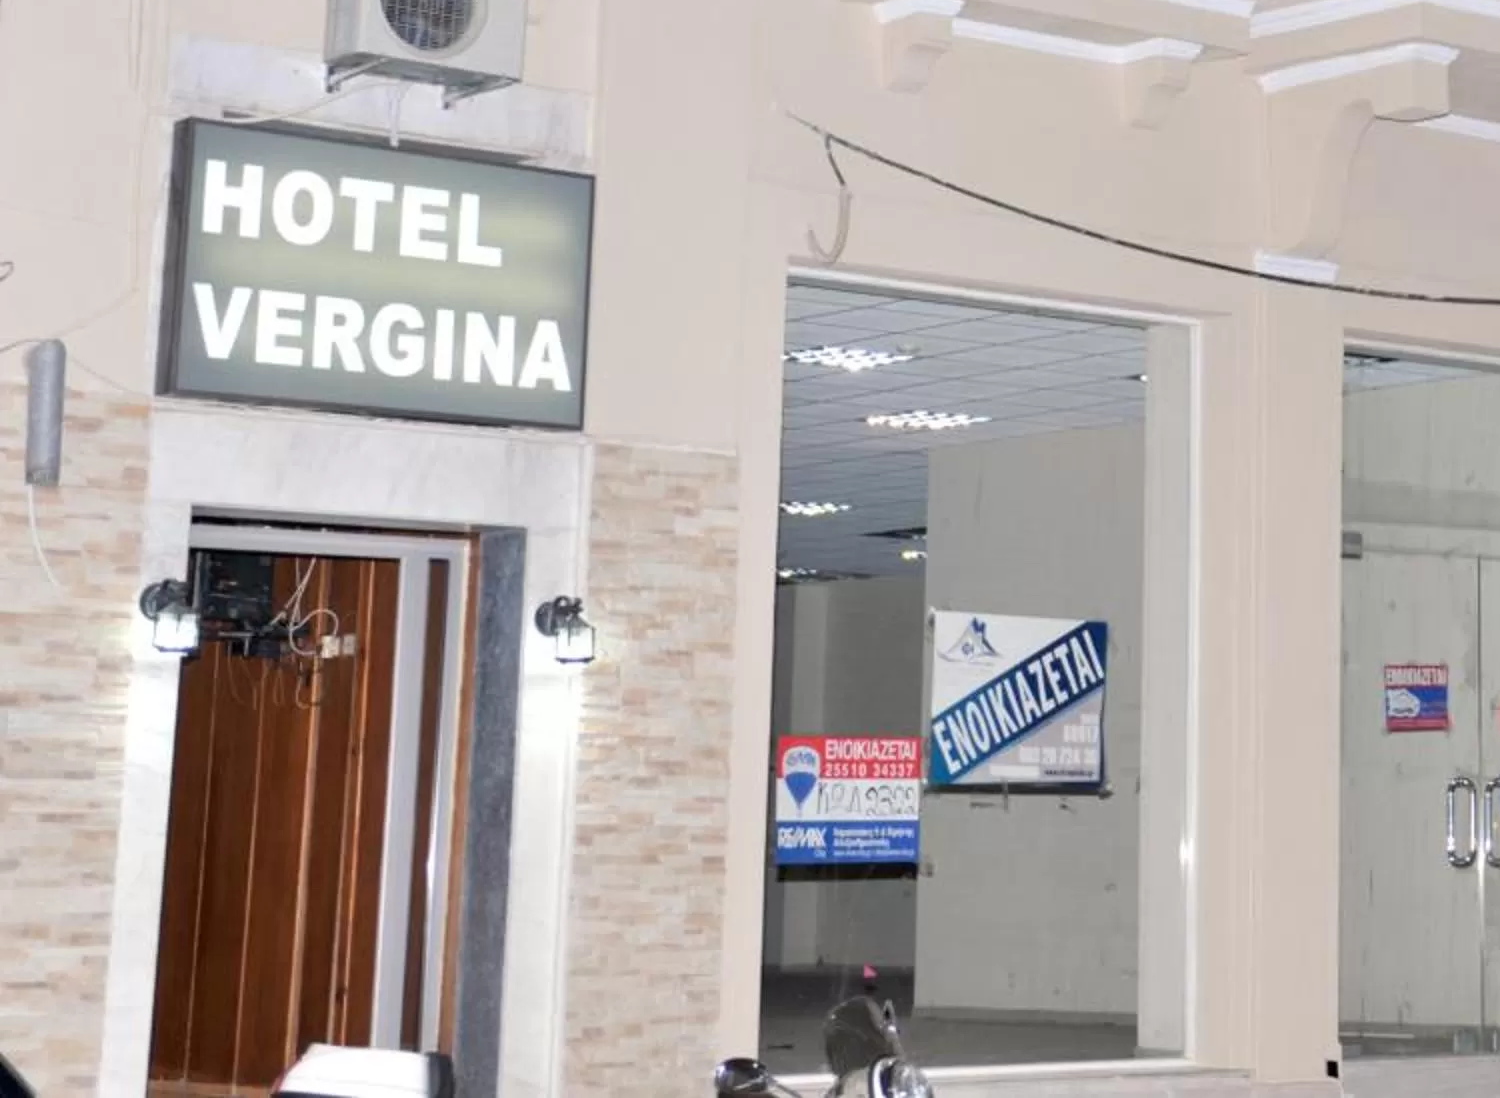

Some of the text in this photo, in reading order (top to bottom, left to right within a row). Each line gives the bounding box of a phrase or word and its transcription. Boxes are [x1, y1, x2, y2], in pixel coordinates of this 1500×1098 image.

[201, 159, 502, 267] HOTEL
[192, 282, 572, 392] VERGINA
[825, 739, 917, 760] ΕΝΟΙΚΙΑΖΕΤΑΙ
[932, 629, 1105, 775] ΕΝΟΙΚΙΑΖΕΤΑΙ
